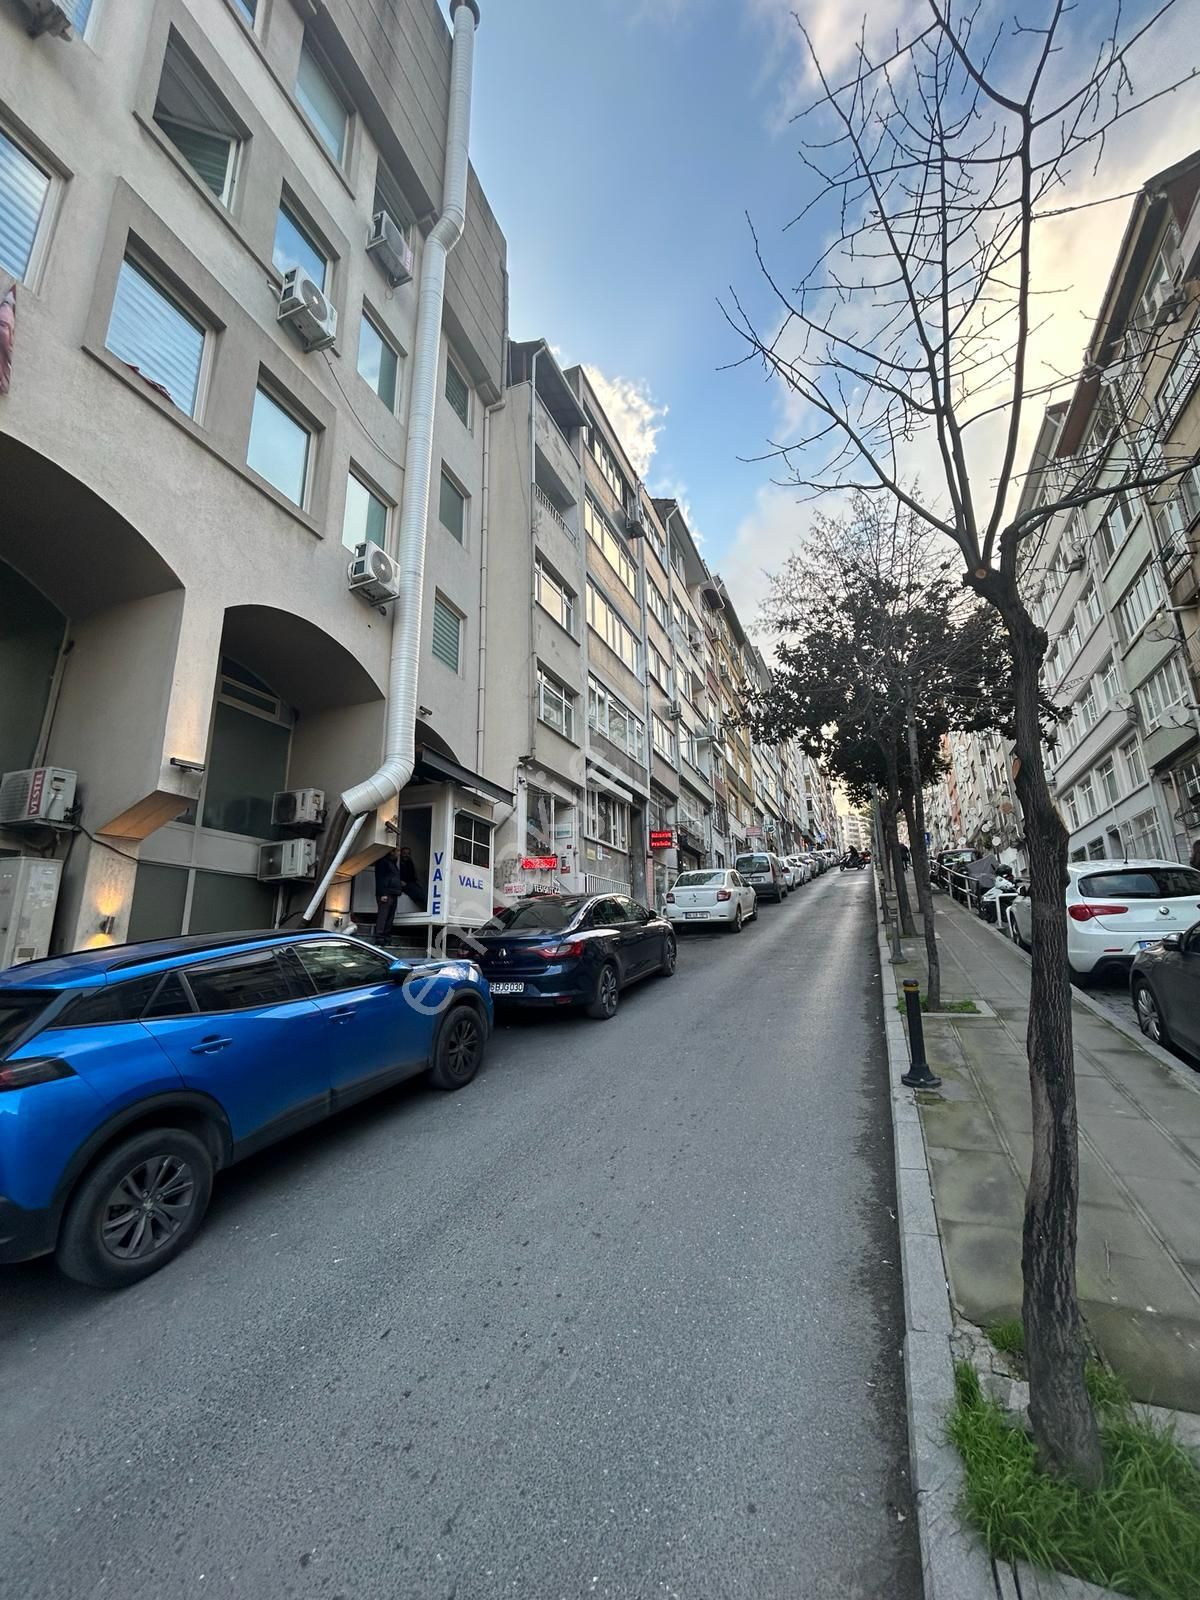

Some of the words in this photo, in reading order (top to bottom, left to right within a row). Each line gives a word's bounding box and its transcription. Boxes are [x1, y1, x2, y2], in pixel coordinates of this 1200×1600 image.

[29, 773, 43, 813] VESTEL
[432, 852, 443, 915] VALE
[459, 875, 483, 890] VALE
